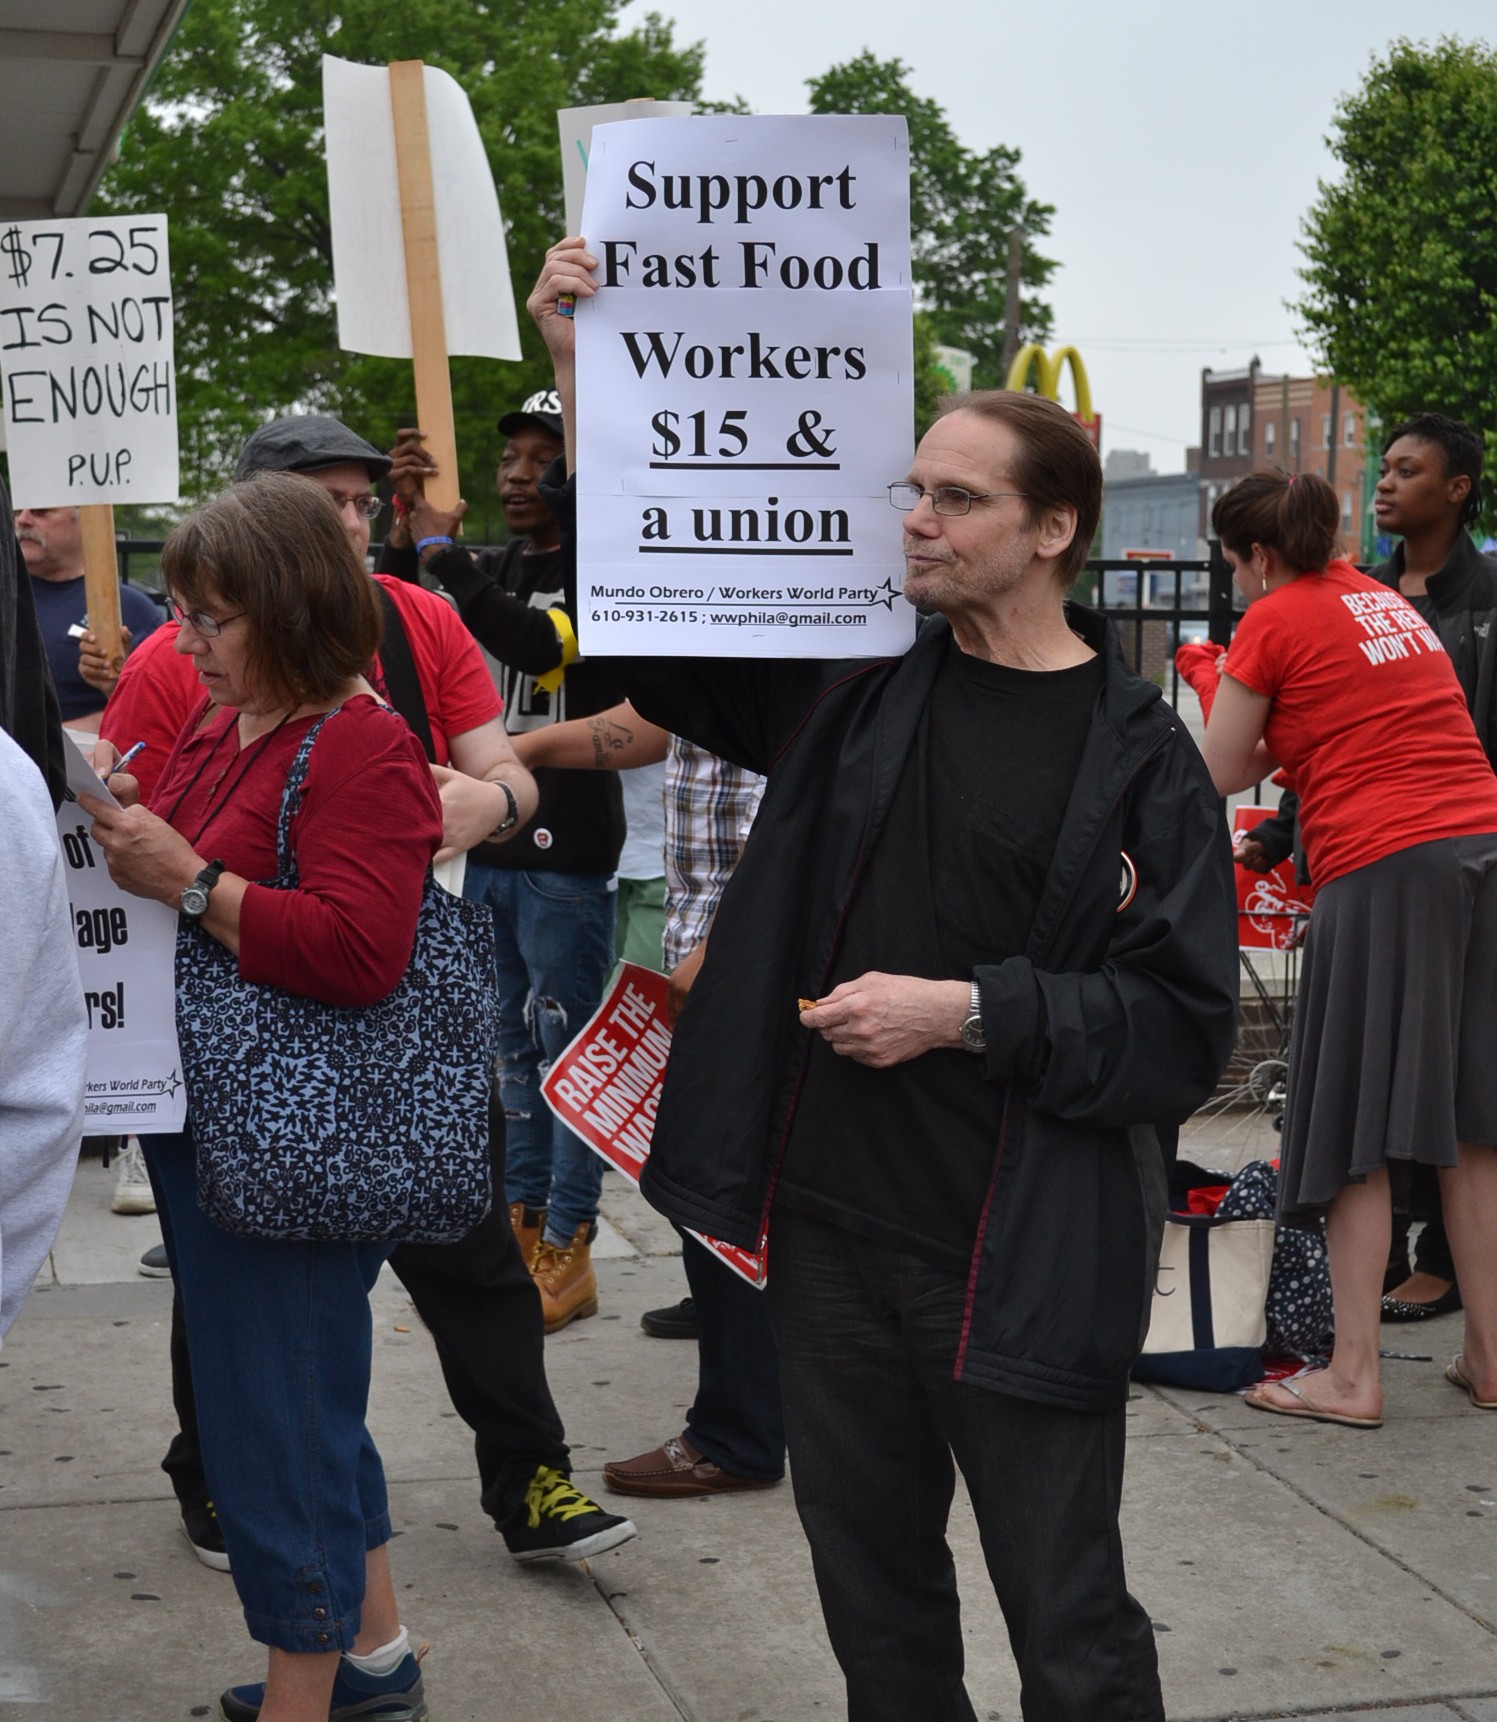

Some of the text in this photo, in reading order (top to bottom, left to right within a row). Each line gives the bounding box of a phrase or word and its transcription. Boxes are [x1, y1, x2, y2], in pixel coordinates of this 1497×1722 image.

[625, 160, 857, 224] Support
[0, 225, 159, 288] $7.25
[600, 240, 883, 291] Fast Food
[0, 297, 171, 350] IS NOT
[618, 332, 868, 380] Workers
[8, 361, 171, 424] ENOUGH
[651, 409, 837, 460] $15 &
[68, 448, 132, 487] P.U.P.
[641, 496, 852, 543] a union
[590, 585, 879, 603] Mundo Obrero / Workers World Party
[1340, 590, 1412, 617] BECAUS
[591, 610, 699, 623] 610-931-2615
[709, 611, 868, 628] wwphila@gmail.com
[1353, 611, 1399, 638] THE
[1358, 630, 1423, 667] WON'T
[62, 824, 96, 870] of
[69, 902, 129, 954] age
[84, 981, 125, 1030] rs!
[553, 982, 657, 1114] RAISE THE
[86, 1079, 168, 1093] kers World Party
[581, 1018, 674, 1140] MINIMUM
